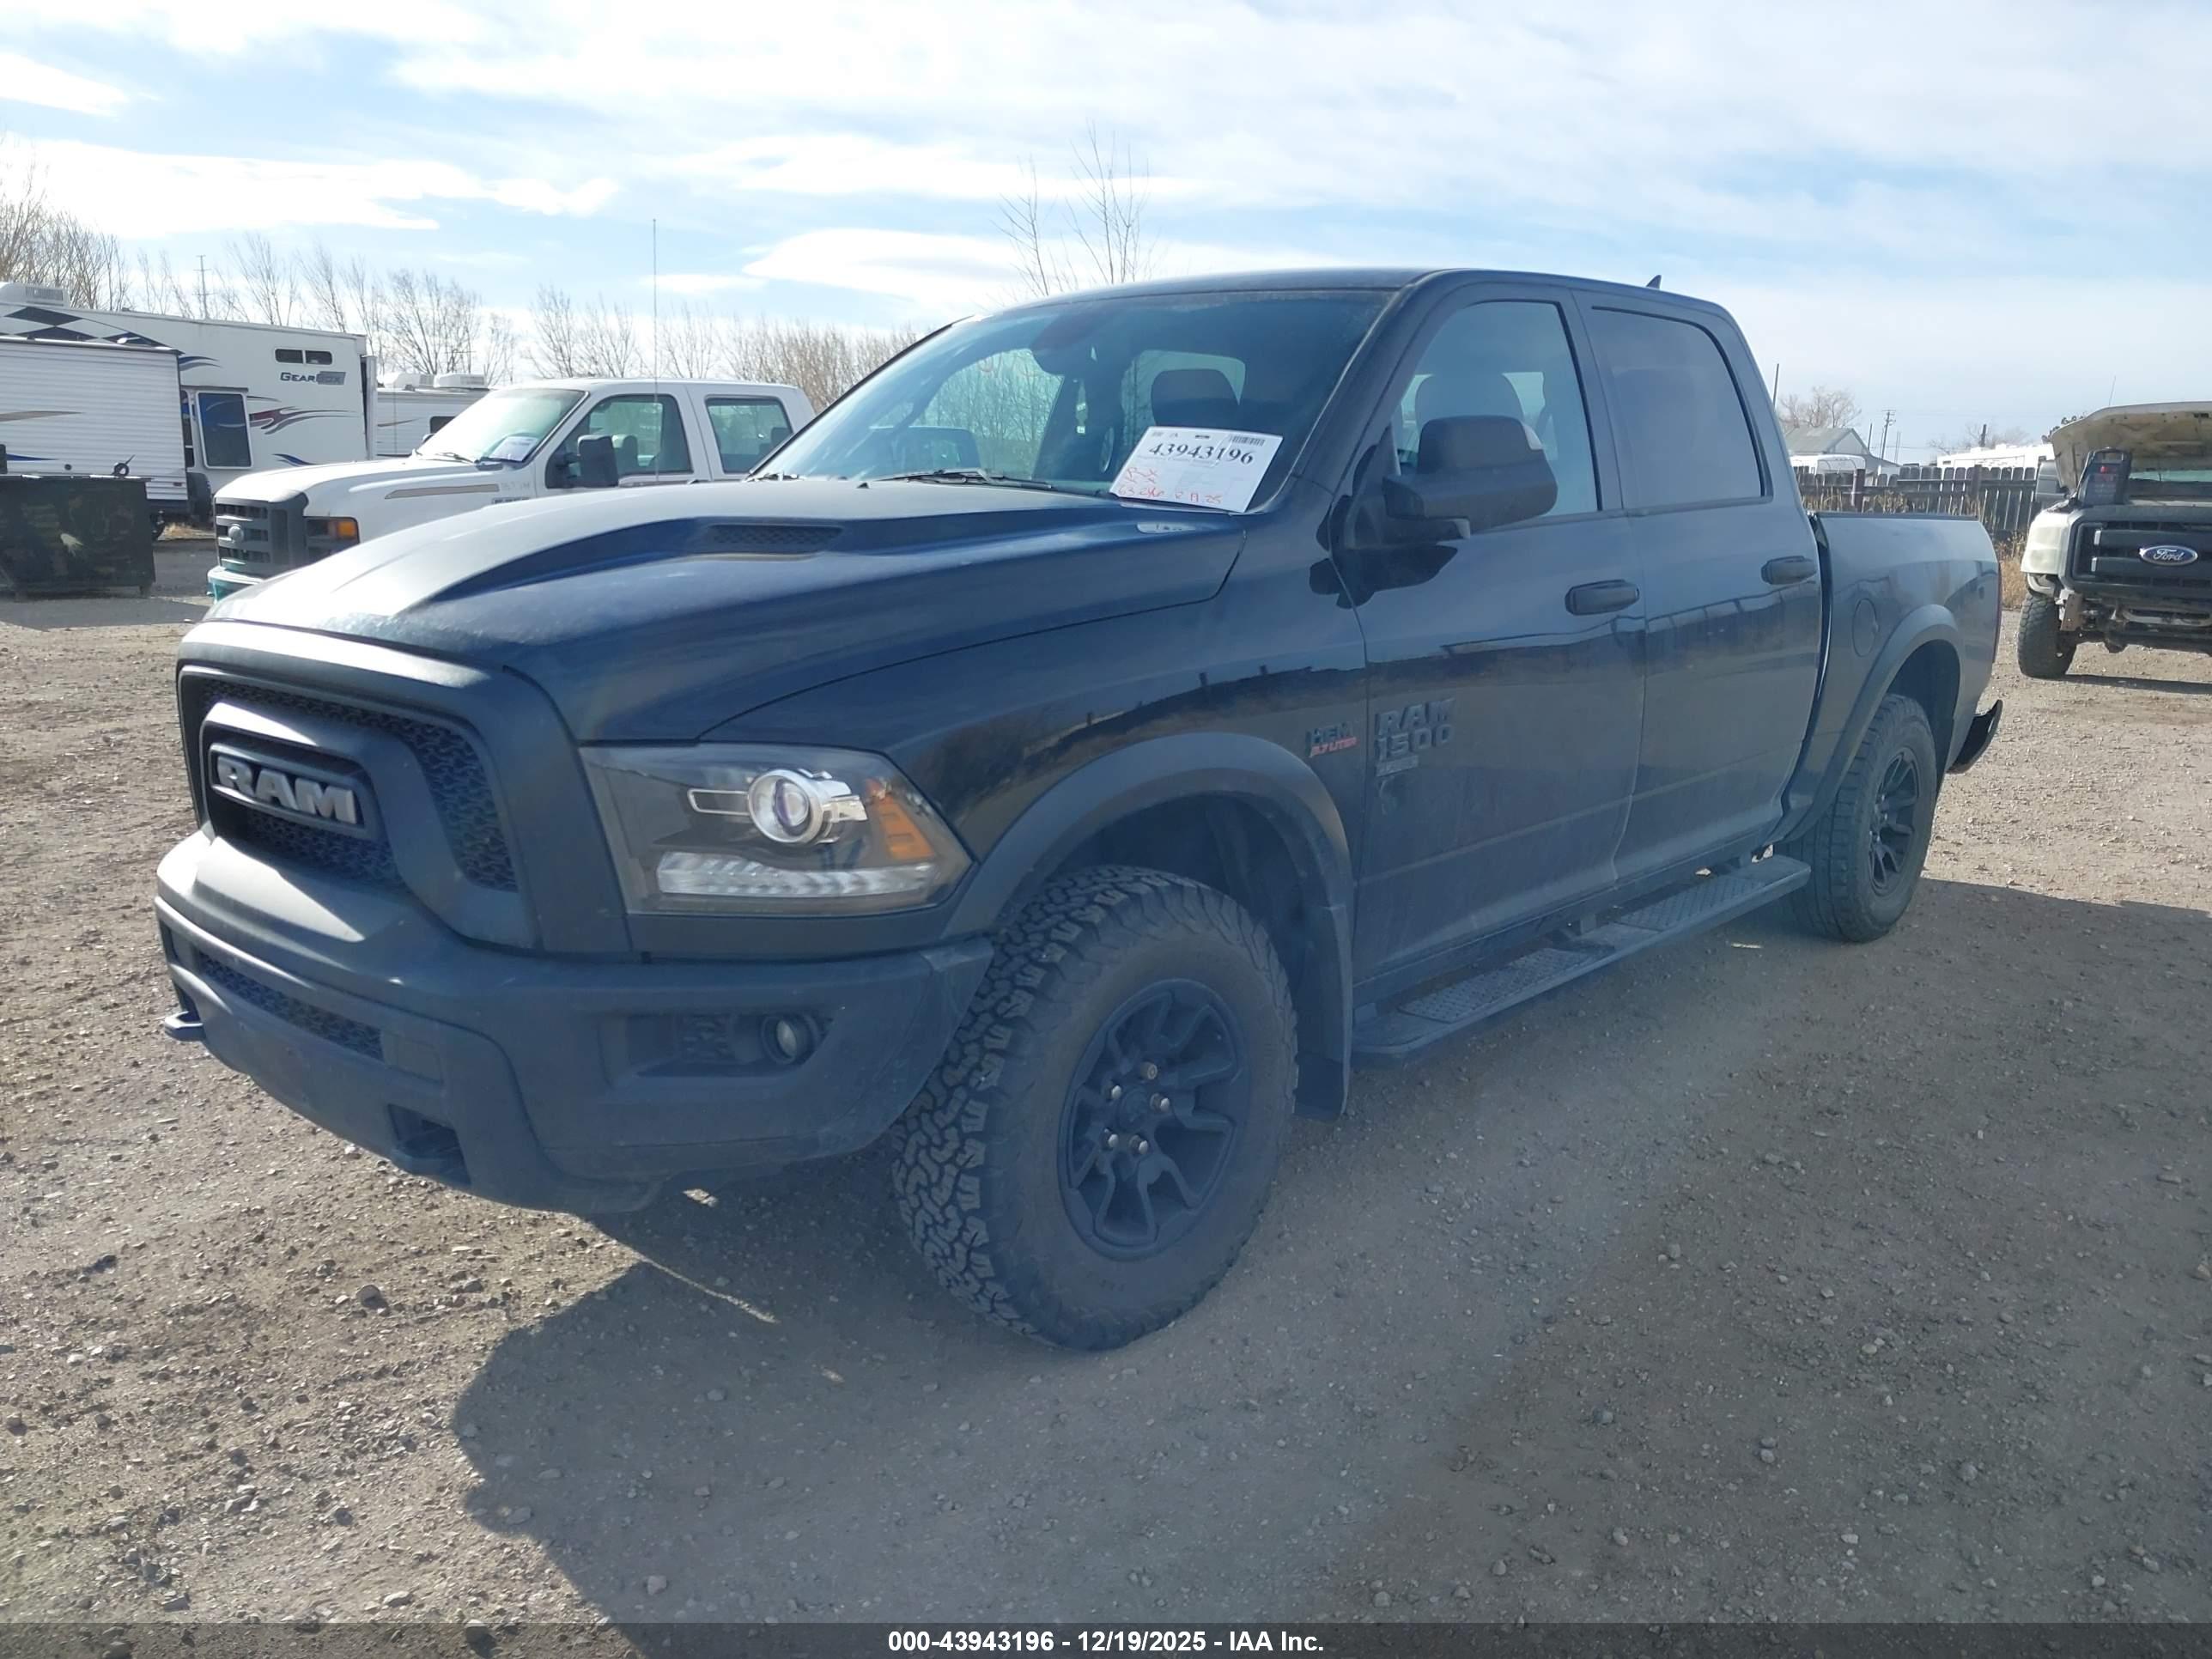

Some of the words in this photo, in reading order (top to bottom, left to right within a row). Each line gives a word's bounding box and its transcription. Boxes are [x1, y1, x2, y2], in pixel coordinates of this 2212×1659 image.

[1149, 443, 1255, 465] 43943196
[2154, 547, 2185, 562] Ford
[1376, 698, 1454, 736] RAM
[1375, 723, 1453, 761] 1500
[216, 755, 356, 824] RAM
